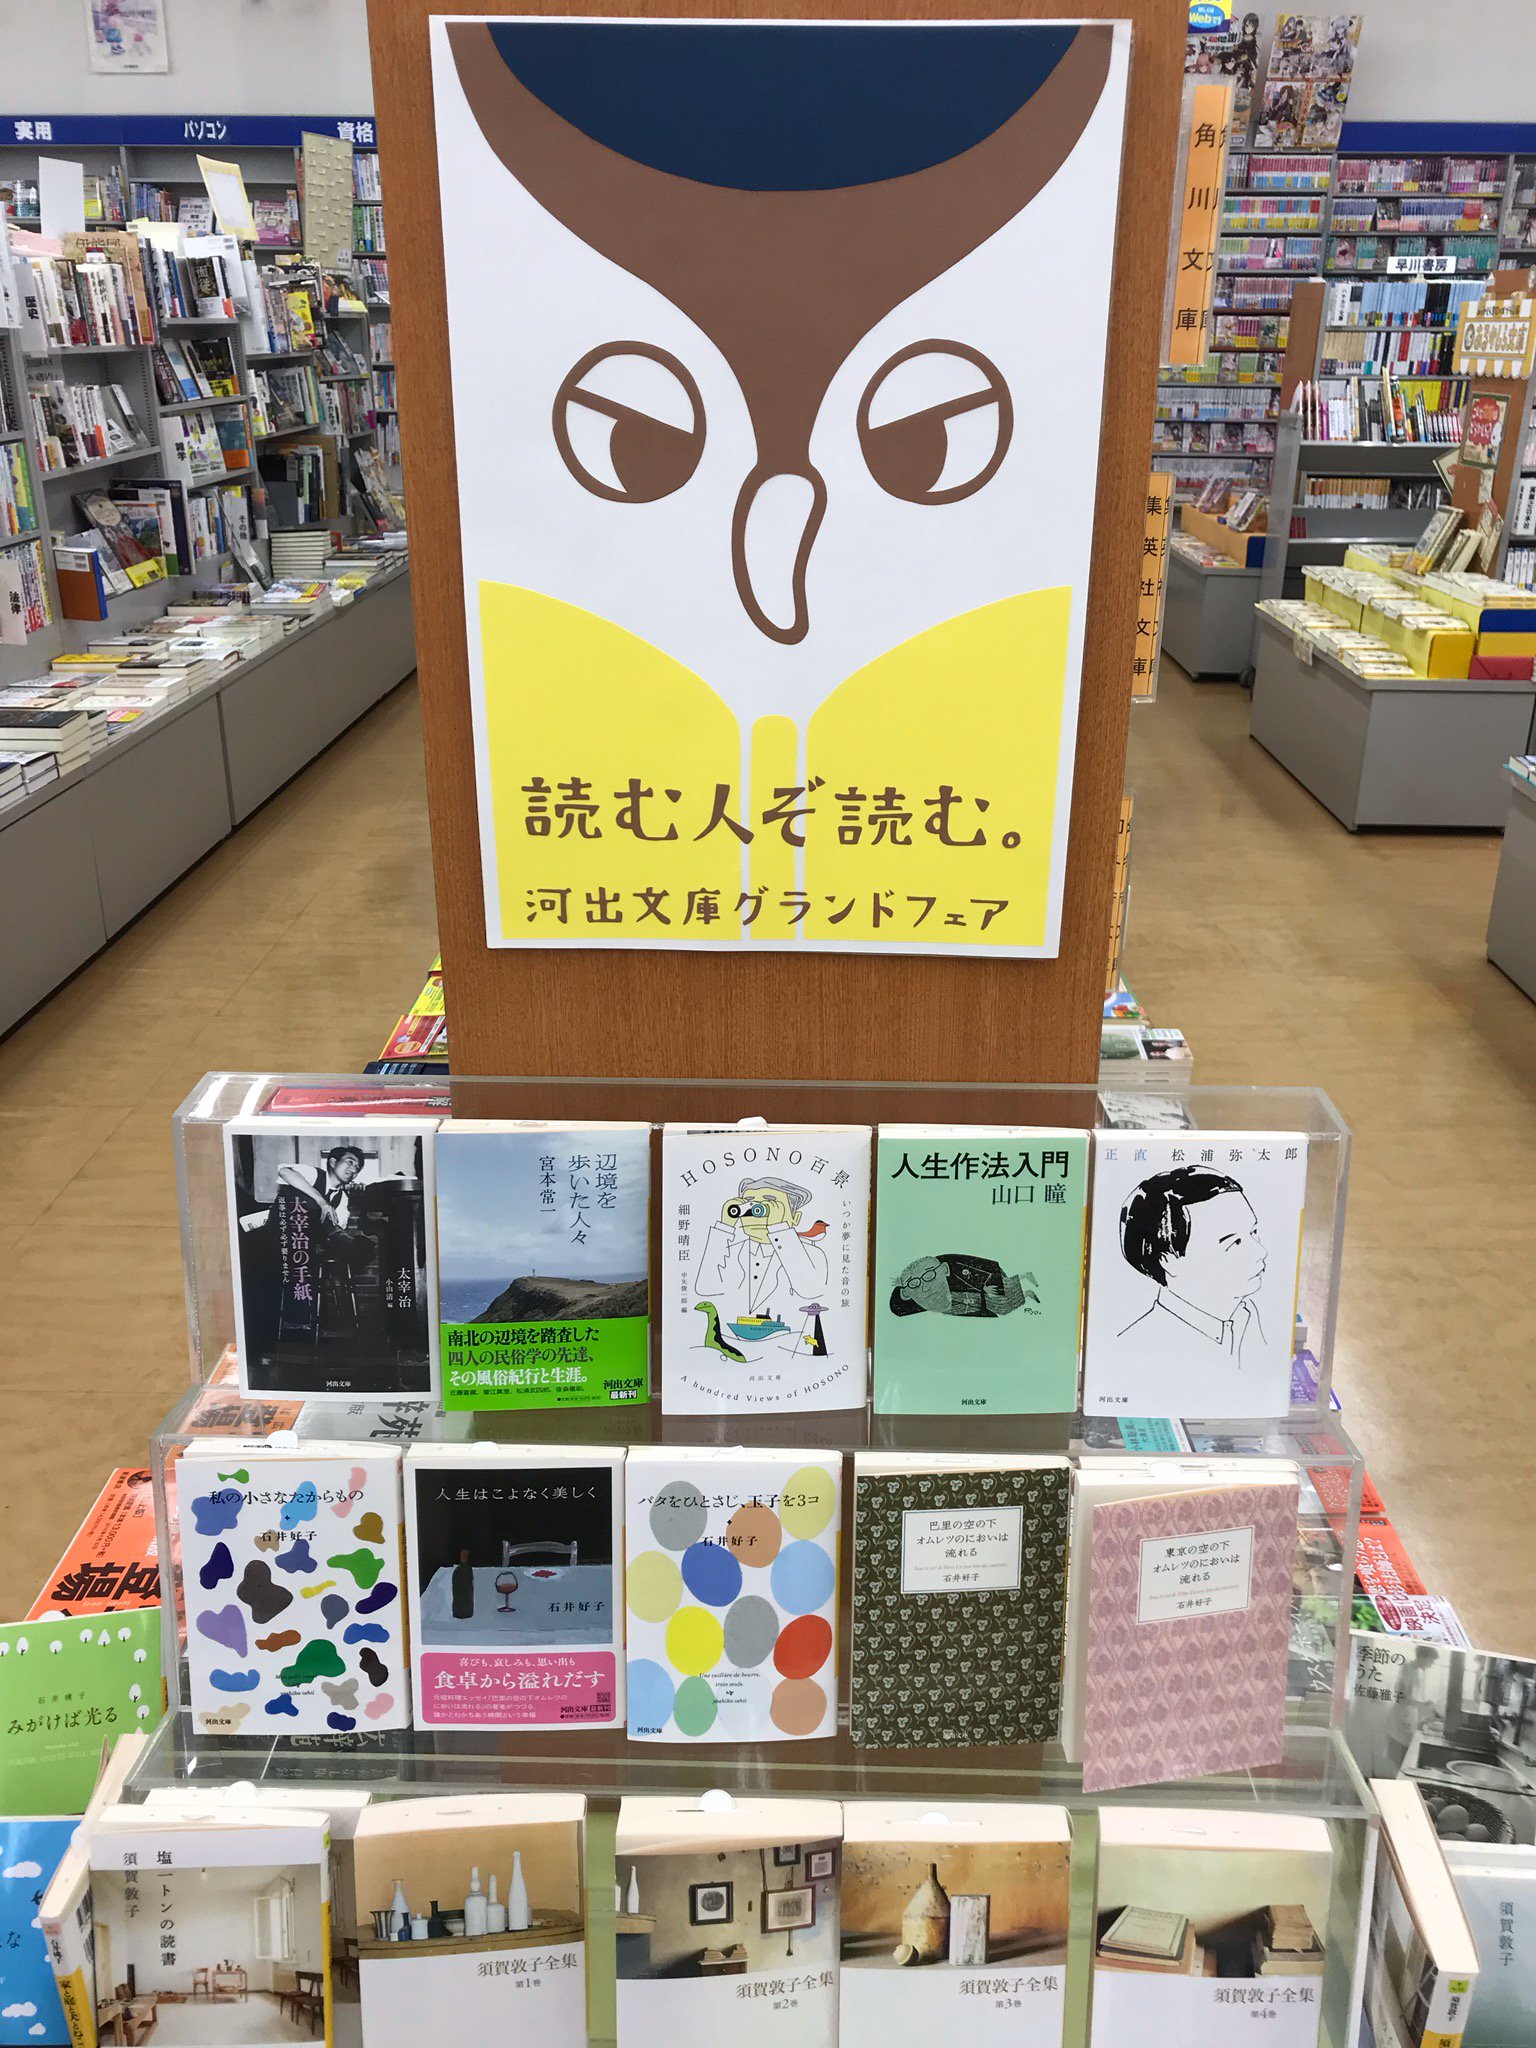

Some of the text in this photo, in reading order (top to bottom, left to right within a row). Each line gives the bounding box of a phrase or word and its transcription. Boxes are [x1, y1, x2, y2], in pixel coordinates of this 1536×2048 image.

[14, 120, 52, 140] 実用
[184, 120, 227, 140] パソコン
[337, 121, 374, 143] 資格
[1174, 122, 1216, 332] 角川文庫
[1395, 258, 1448, 272] 早川書房
[239, 515, 247, 540] その他
[1132, 496, 1162, 676] 集英社文庫
[9, 591, 22, 614] 法律
[520, 776, 1022, 849] 読む人ぞ読む。
[525, 886, 1010, 931] 河出文庫グランドフェア
[891, 1150, 1070, 1180] 人生作法入門
[538, 1155, 557, 1214] 宮本常一
[595, 1152, 618, 1210] 辺境を
[568, 1155, 591, 1246] 歩いた人々
[678, 1204, 690, 1262] 細野晴臣
[289, 1197, 312, 1300] 太宰治の手紙
[841, 1200, 852, 1308] いつか夢に見た音の旅
[448, 1327, 599, 1346] 南北の辺境を踏査した
[448, 1348, 594, 1366] 四人の民俗学の先達、
[449, 1367, 587, 1387] その風俗紀行と生涯。
[603, 1378, 644, 1390] 河出文庫
[692, 1381, 739, 1401] hundred
[787, 1390, 797, 1399] of
[804, 1364, 849, 1394] HOSONO
[610, 1390, 637, 1399] 最新刊
[1099, 1395, 1129, 1404] 河出文庫
[208, 1488, 363, 1506] 私の小さなたからもの
[435, 1486, 597, 1501] 人生はこよなく美しく
[930, 1519, 997, 1531] 巴里の空の下
[260, 1530, 318, 1543] 石井好子
[700, 1535, 758, 1548] 石井好子
[916, 1533, 1008, 1545] オムレツのにおいは
[945, 1548, 978, 1558] 流れる
[1165, 1540, 1230, 1558] 東京の空の下
[1152, 1554, 1240, 1574] オムレツのにおいは
[943, 1573, 980, 1582] 石井好子
[1180, 1572, 1210, 1584] 流れる
[548, 1600, 606, 1613] 石井好子
[1177, 1597, 1212, 1609] 石井好子
[1357, 1644, 1406, 1667] 季節の
[434, 1671, 605, 1690] 食卓から溢れだす
[1357, 1664, 1383, 1682] うた
[1354, 1684, 1405, 1703] 佐藤雅子
[8, 1707, 118, 1735] みがけば光る
[636, 1726, 663, 1735] 河出文庫
[122, 1851, 142, 1919] 須賀敦子
[156, 1850, 177, 1966] 塩一トンの読書
[1499, 1902, 1514, 1966] 須賀敦子
[477, 1952, 578, 1978] 須賀敦子全集
[515, 1978, 542, 1990] 第1巻
[736, 1971, 834, 1999] 須賀敦子全集
[959, 1976, 1059, 1995] 須賀敦子全集
[772, 1998, 799, 2011] 第2巻
[995, 1998, 1022, 2009] 第3巻
[1213, 1988, 1315, 2004] 須賀敦子全集
[1250, 2008, 1277, 2019] 第4巻
